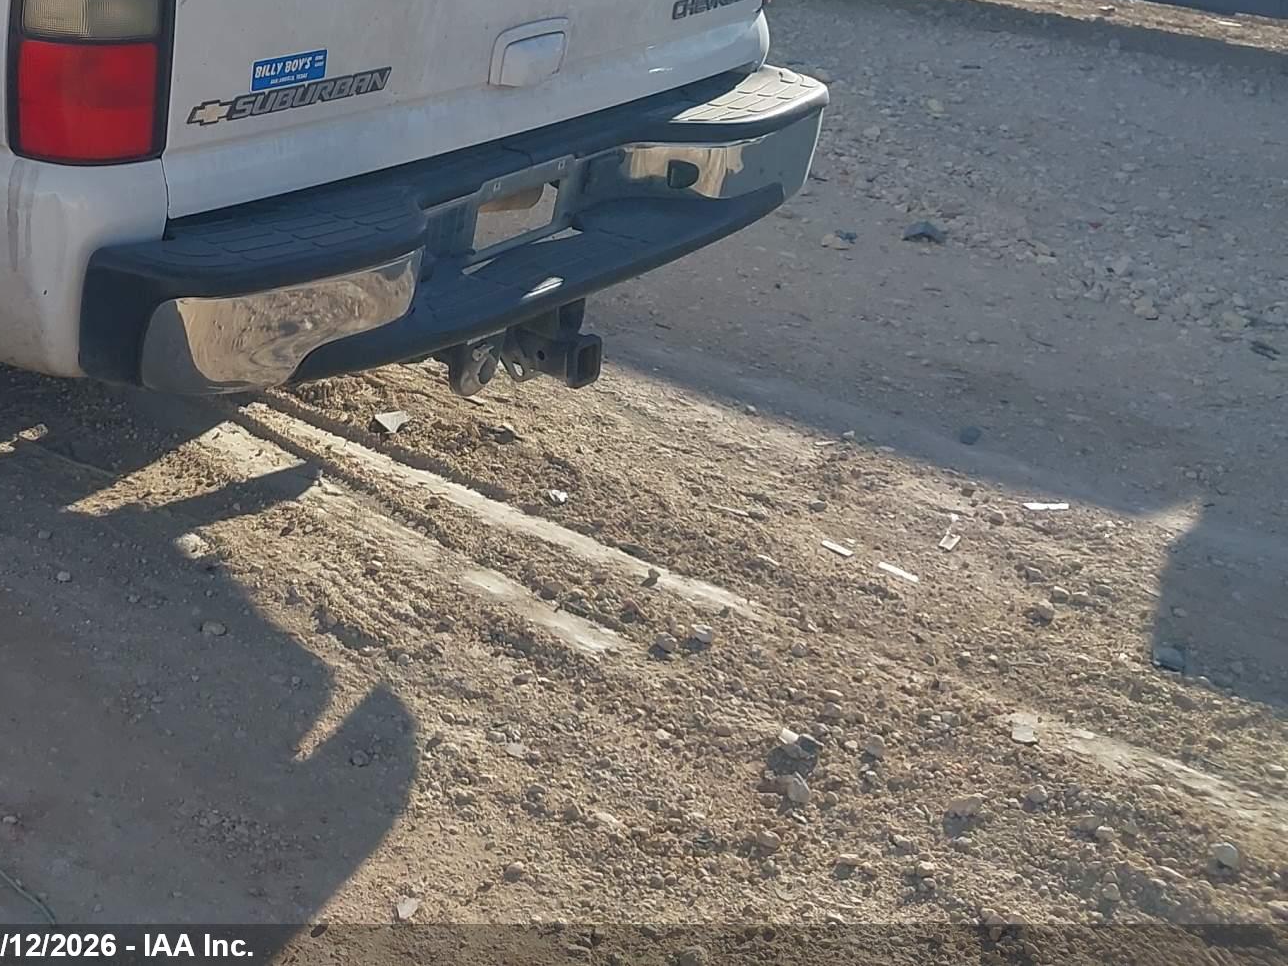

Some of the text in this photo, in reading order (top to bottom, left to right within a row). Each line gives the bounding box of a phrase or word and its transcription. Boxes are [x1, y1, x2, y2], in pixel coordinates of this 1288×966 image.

[254, 62, 284, 79] BILLY
[284, 56, 313, 73] BOY'S
[230, 68, 391, 120] SUBURBAN
